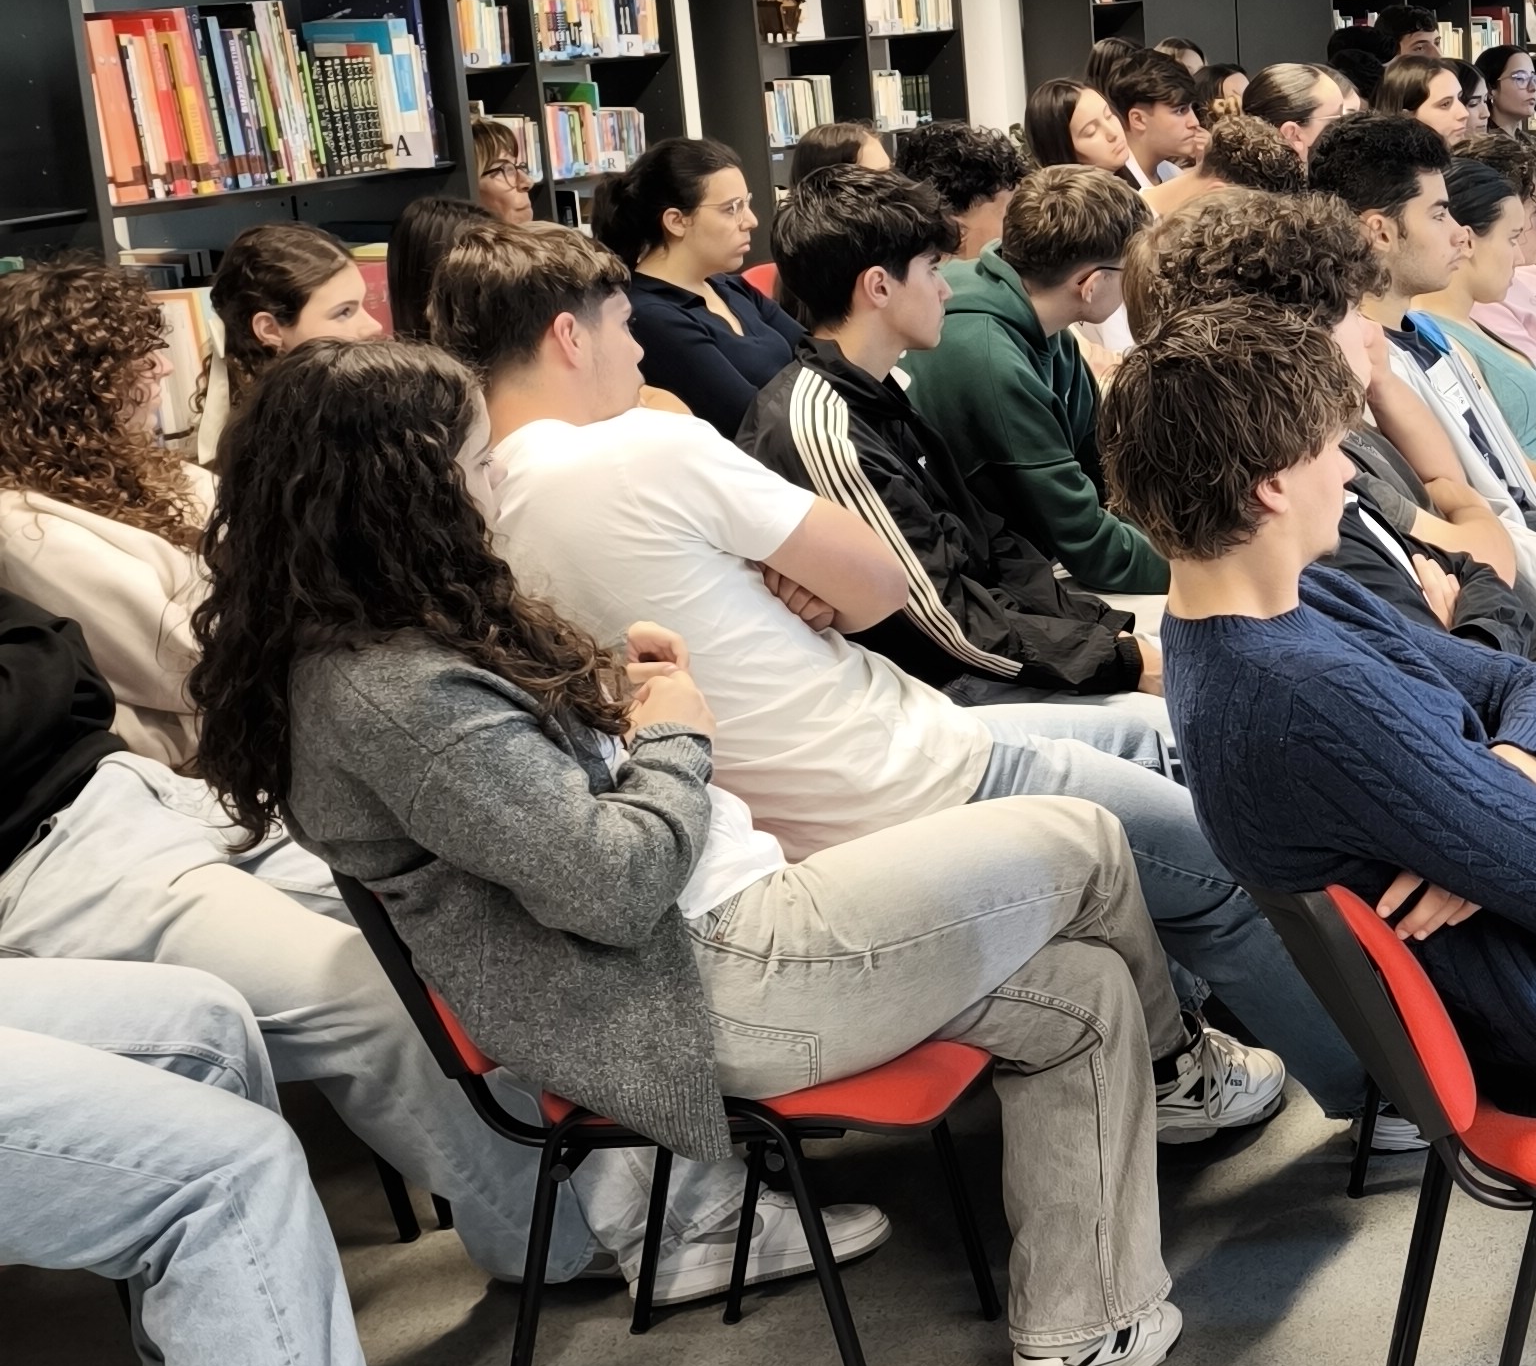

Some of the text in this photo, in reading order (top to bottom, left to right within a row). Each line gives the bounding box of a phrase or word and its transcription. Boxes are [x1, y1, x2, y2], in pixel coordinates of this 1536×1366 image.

[626, 41, 635, 53] P
[469, 51, 480, 65] D
[395, 134, 413, 158] A
[606, 157, 617, 169] R
